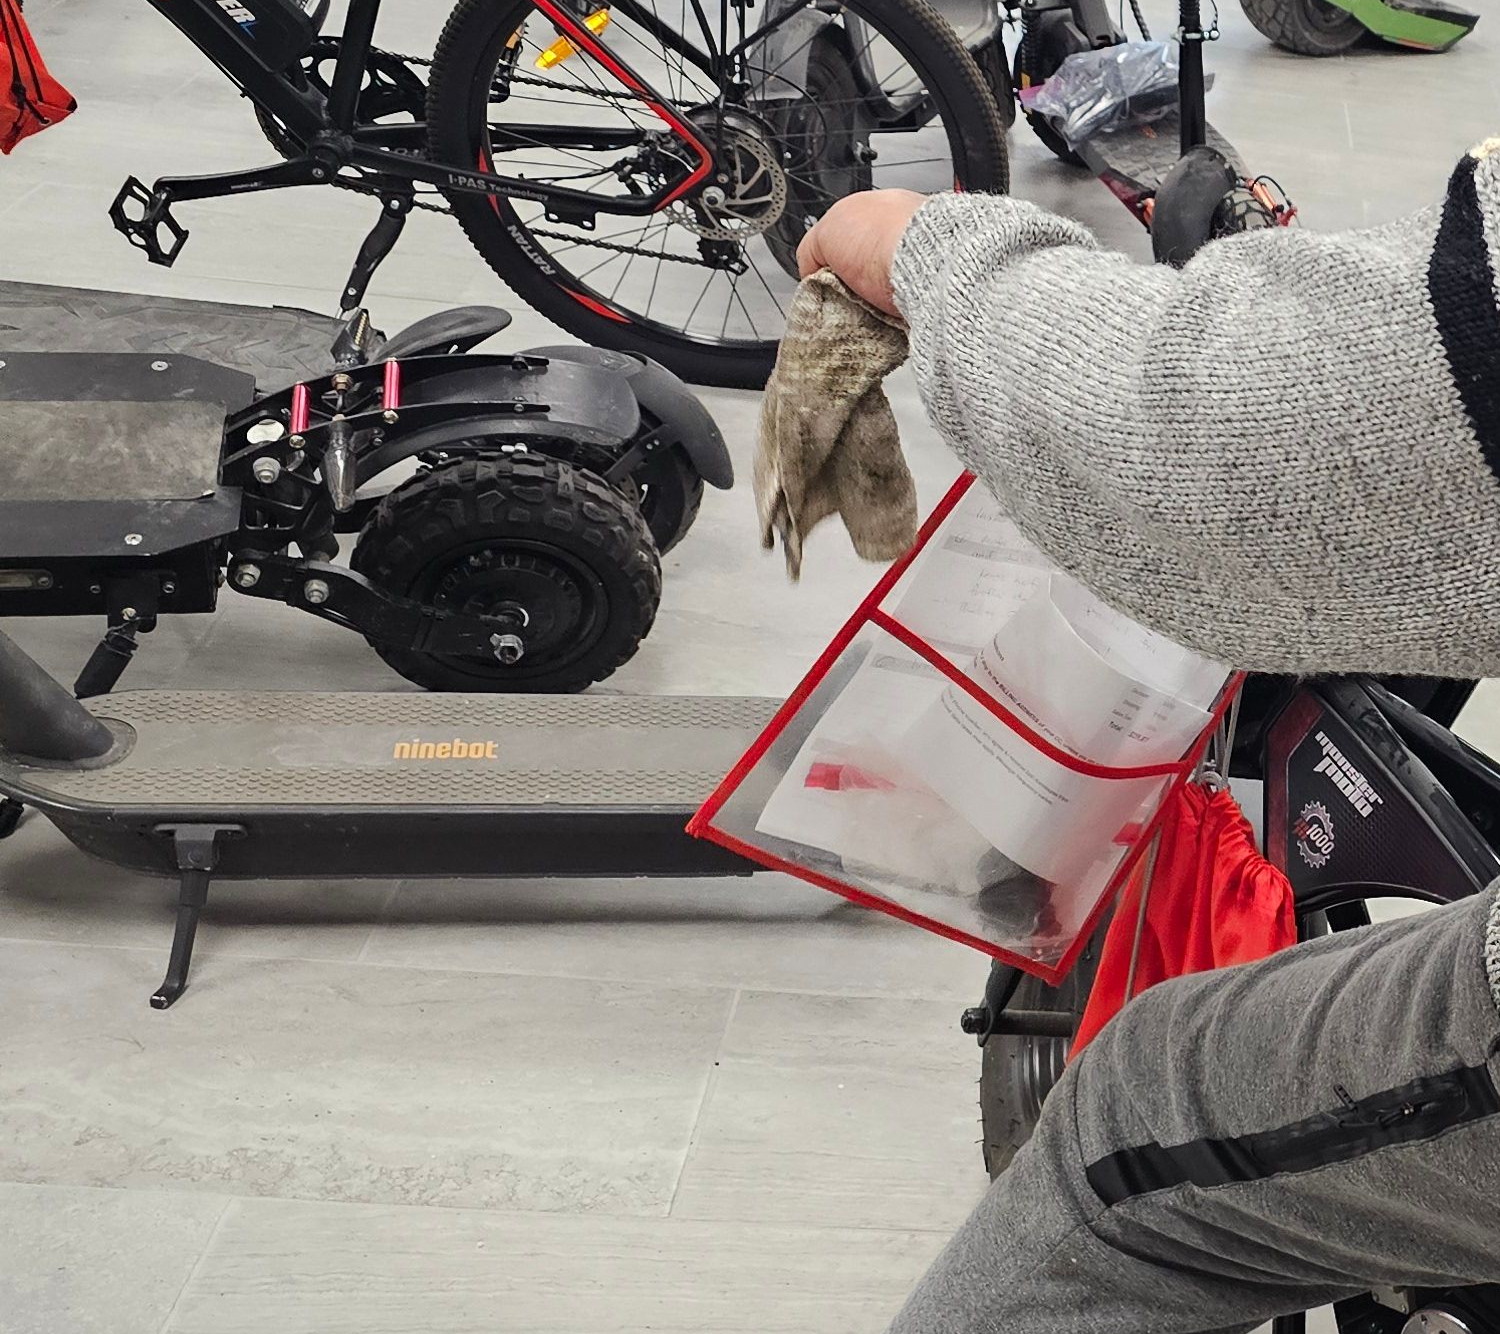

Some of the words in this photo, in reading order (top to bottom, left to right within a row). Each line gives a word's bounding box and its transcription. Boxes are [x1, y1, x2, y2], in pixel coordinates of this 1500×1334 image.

[489, 183, 549, 202] Technology
[507, 225, 556, 276] RATTAN
[393, 738, 498, 759] ninebot
[1306, 824, 1335, 854] 1000
